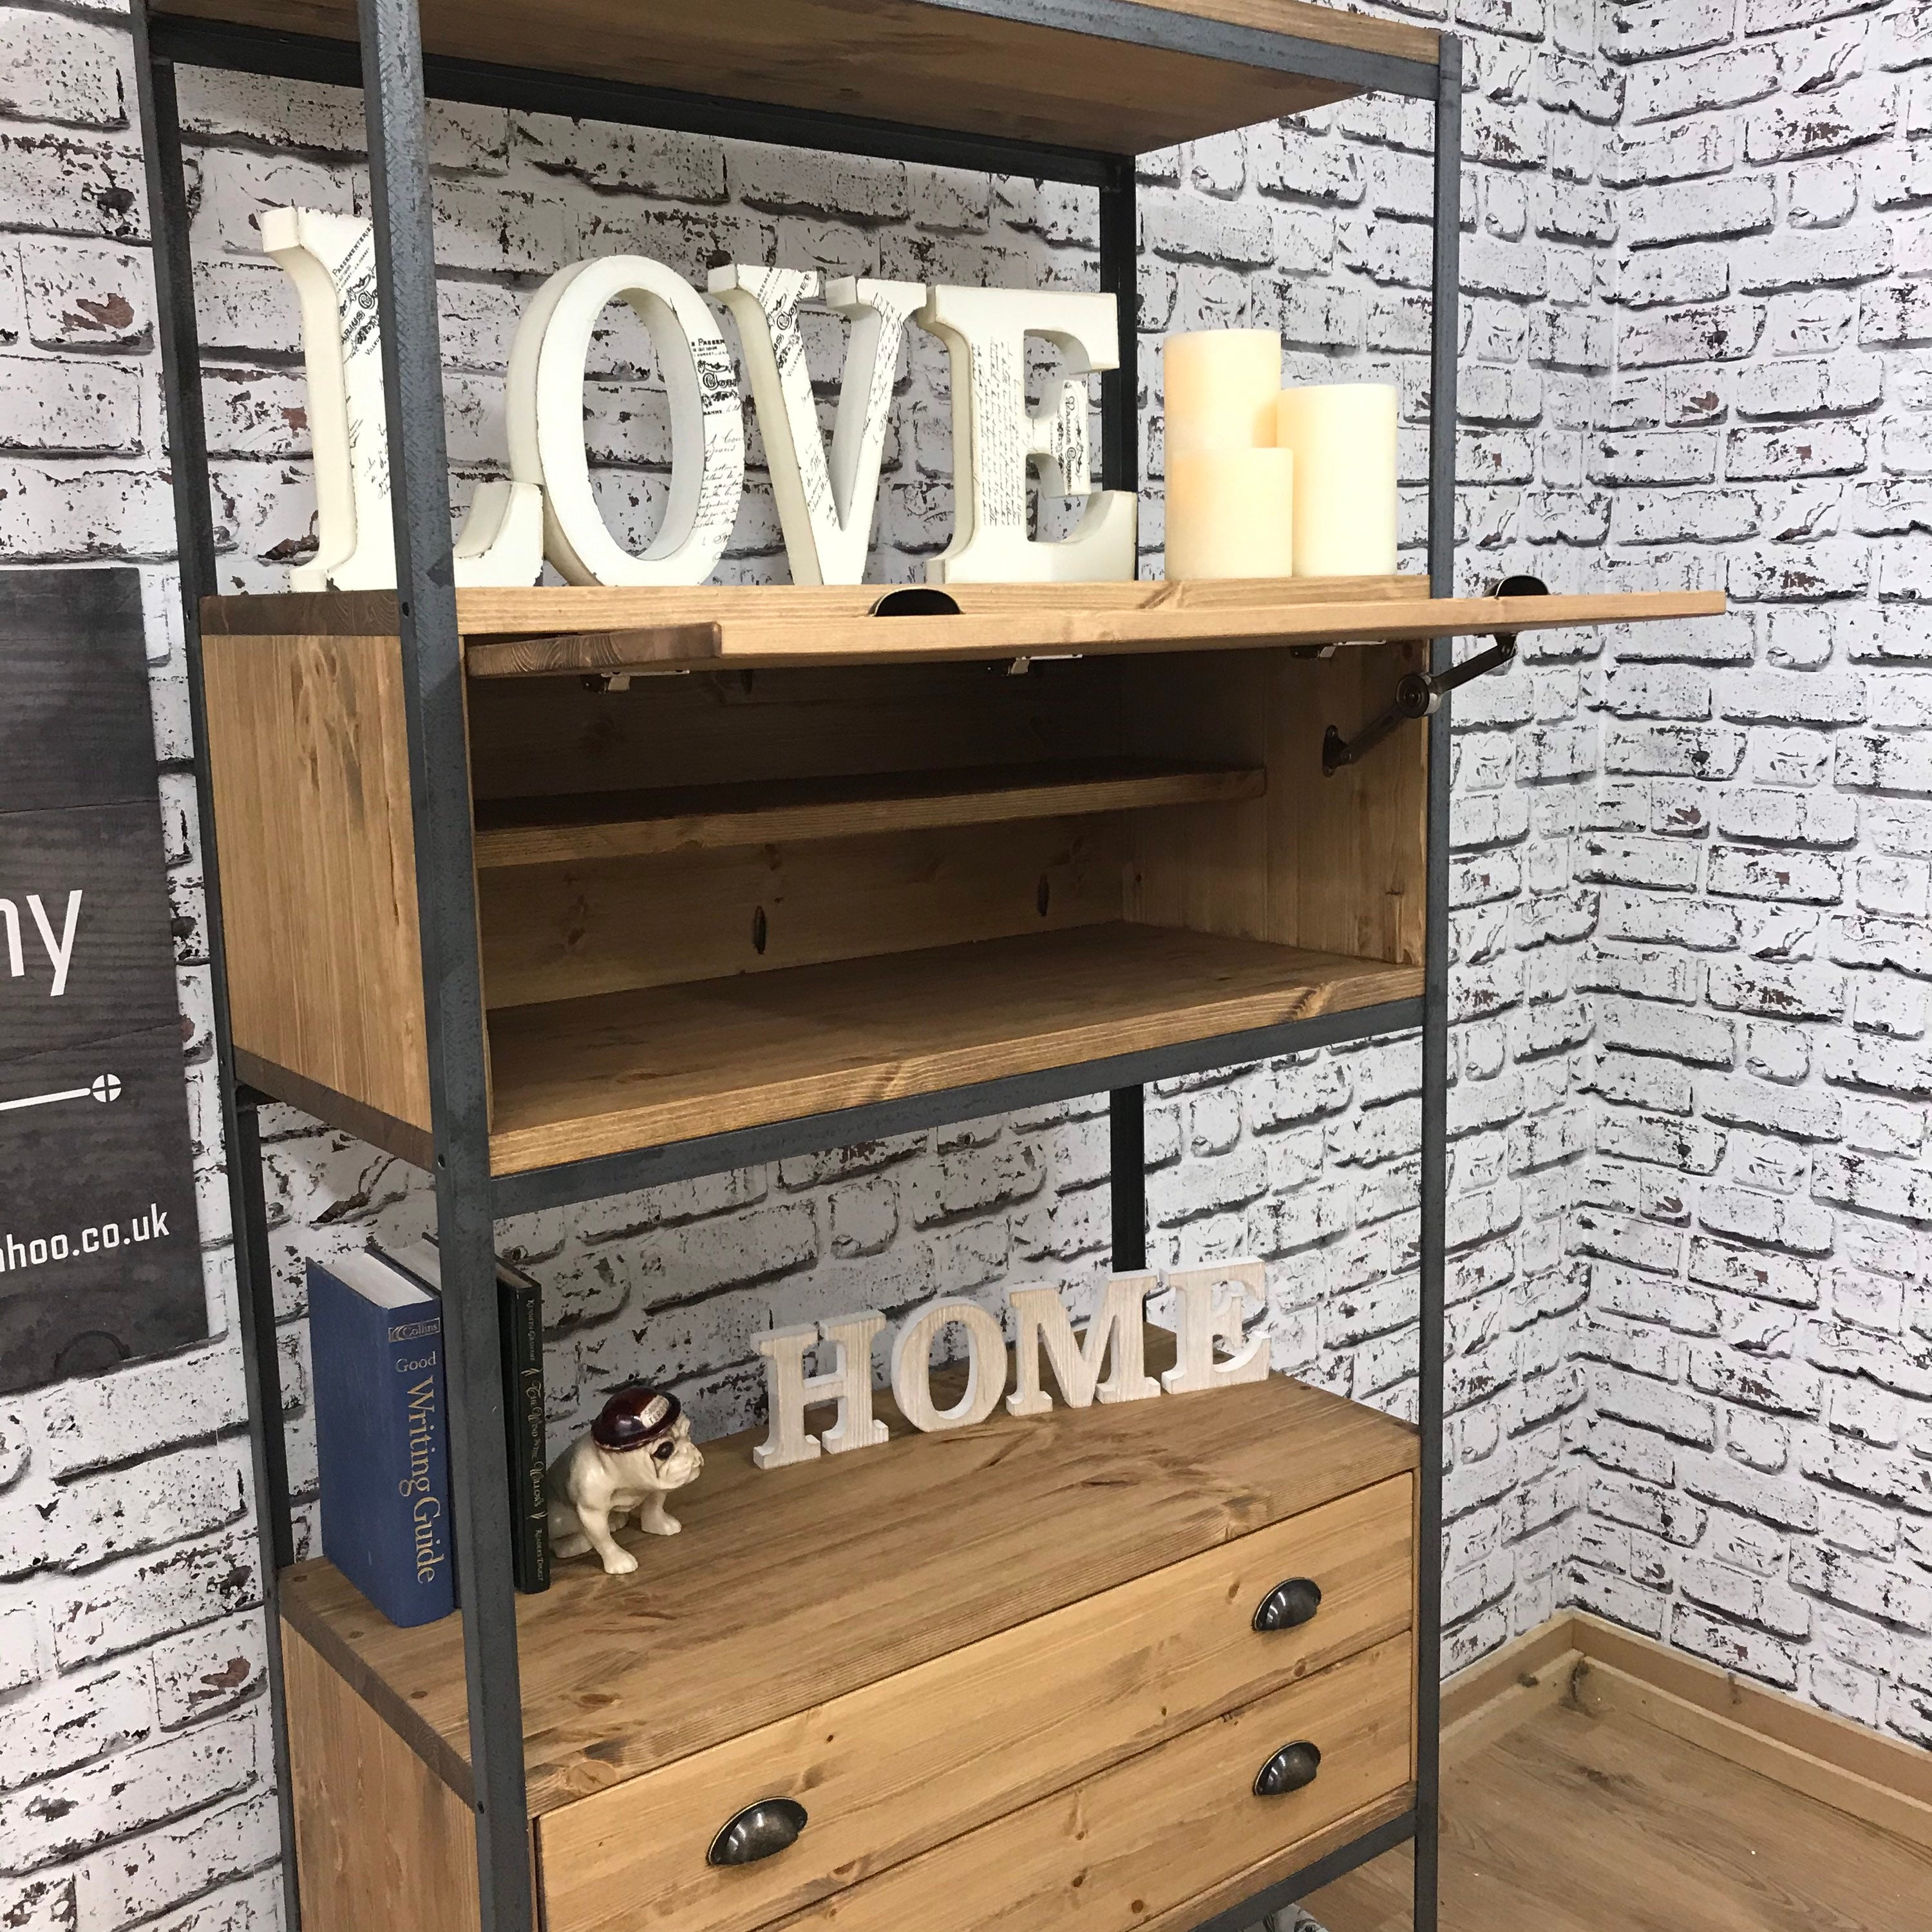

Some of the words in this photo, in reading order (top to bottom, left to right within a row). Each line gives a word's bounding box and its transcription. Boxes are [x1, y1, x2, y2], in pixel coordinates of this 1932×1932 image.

[260, 206, 1137, 585] LOVE
[395, 1351, 437, 1373] Good
[402, 1322, 438, 1338] Collins
[750, 1255, 1271, 1470] HOME
[398, 1375, 435, 1497] Writing
[413, 1497, 444, 1584] Guide
